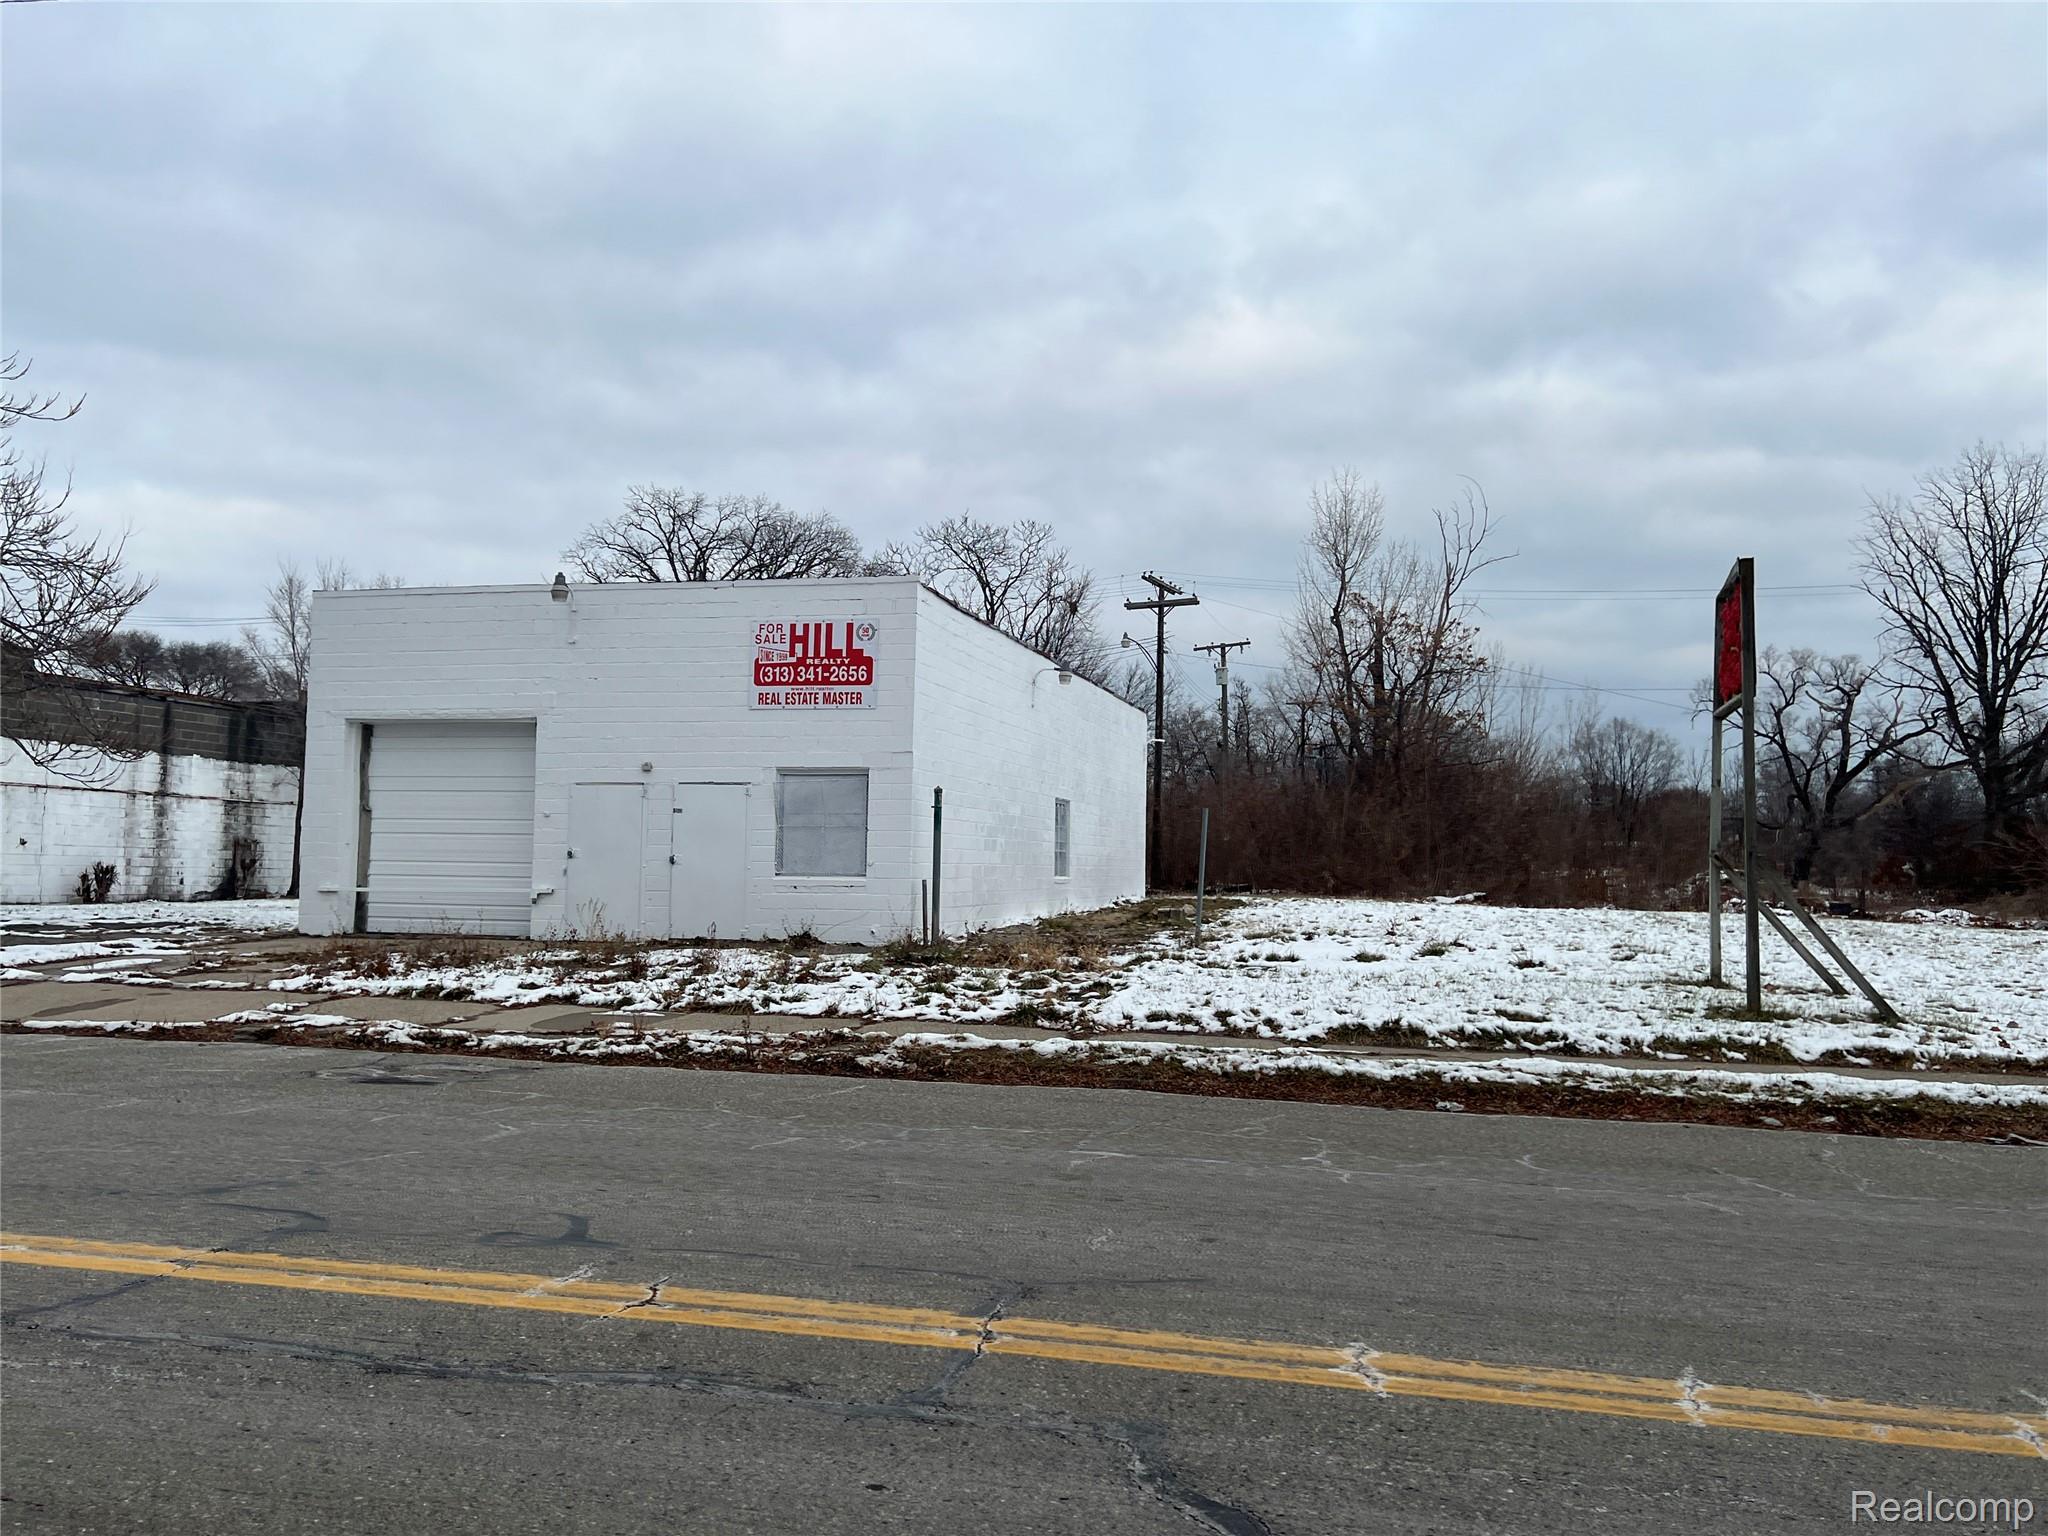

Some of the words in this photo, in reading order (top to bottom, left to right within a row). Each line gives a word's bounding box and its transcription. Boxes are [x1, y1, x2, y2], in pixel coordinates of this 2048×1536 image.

[759, 624, 784, 634] FOR
[755, 634, 786, 644] SALE
[789, 623, 864, 657] HILL
[760, 666, 794, 683] (313)
[797, 666, 867, 681] 341-2656
[758, 692, 782, 705] REAL
[785, 692, 819, 705] ESTATE
[823, 692, 862, 705] MASTER
